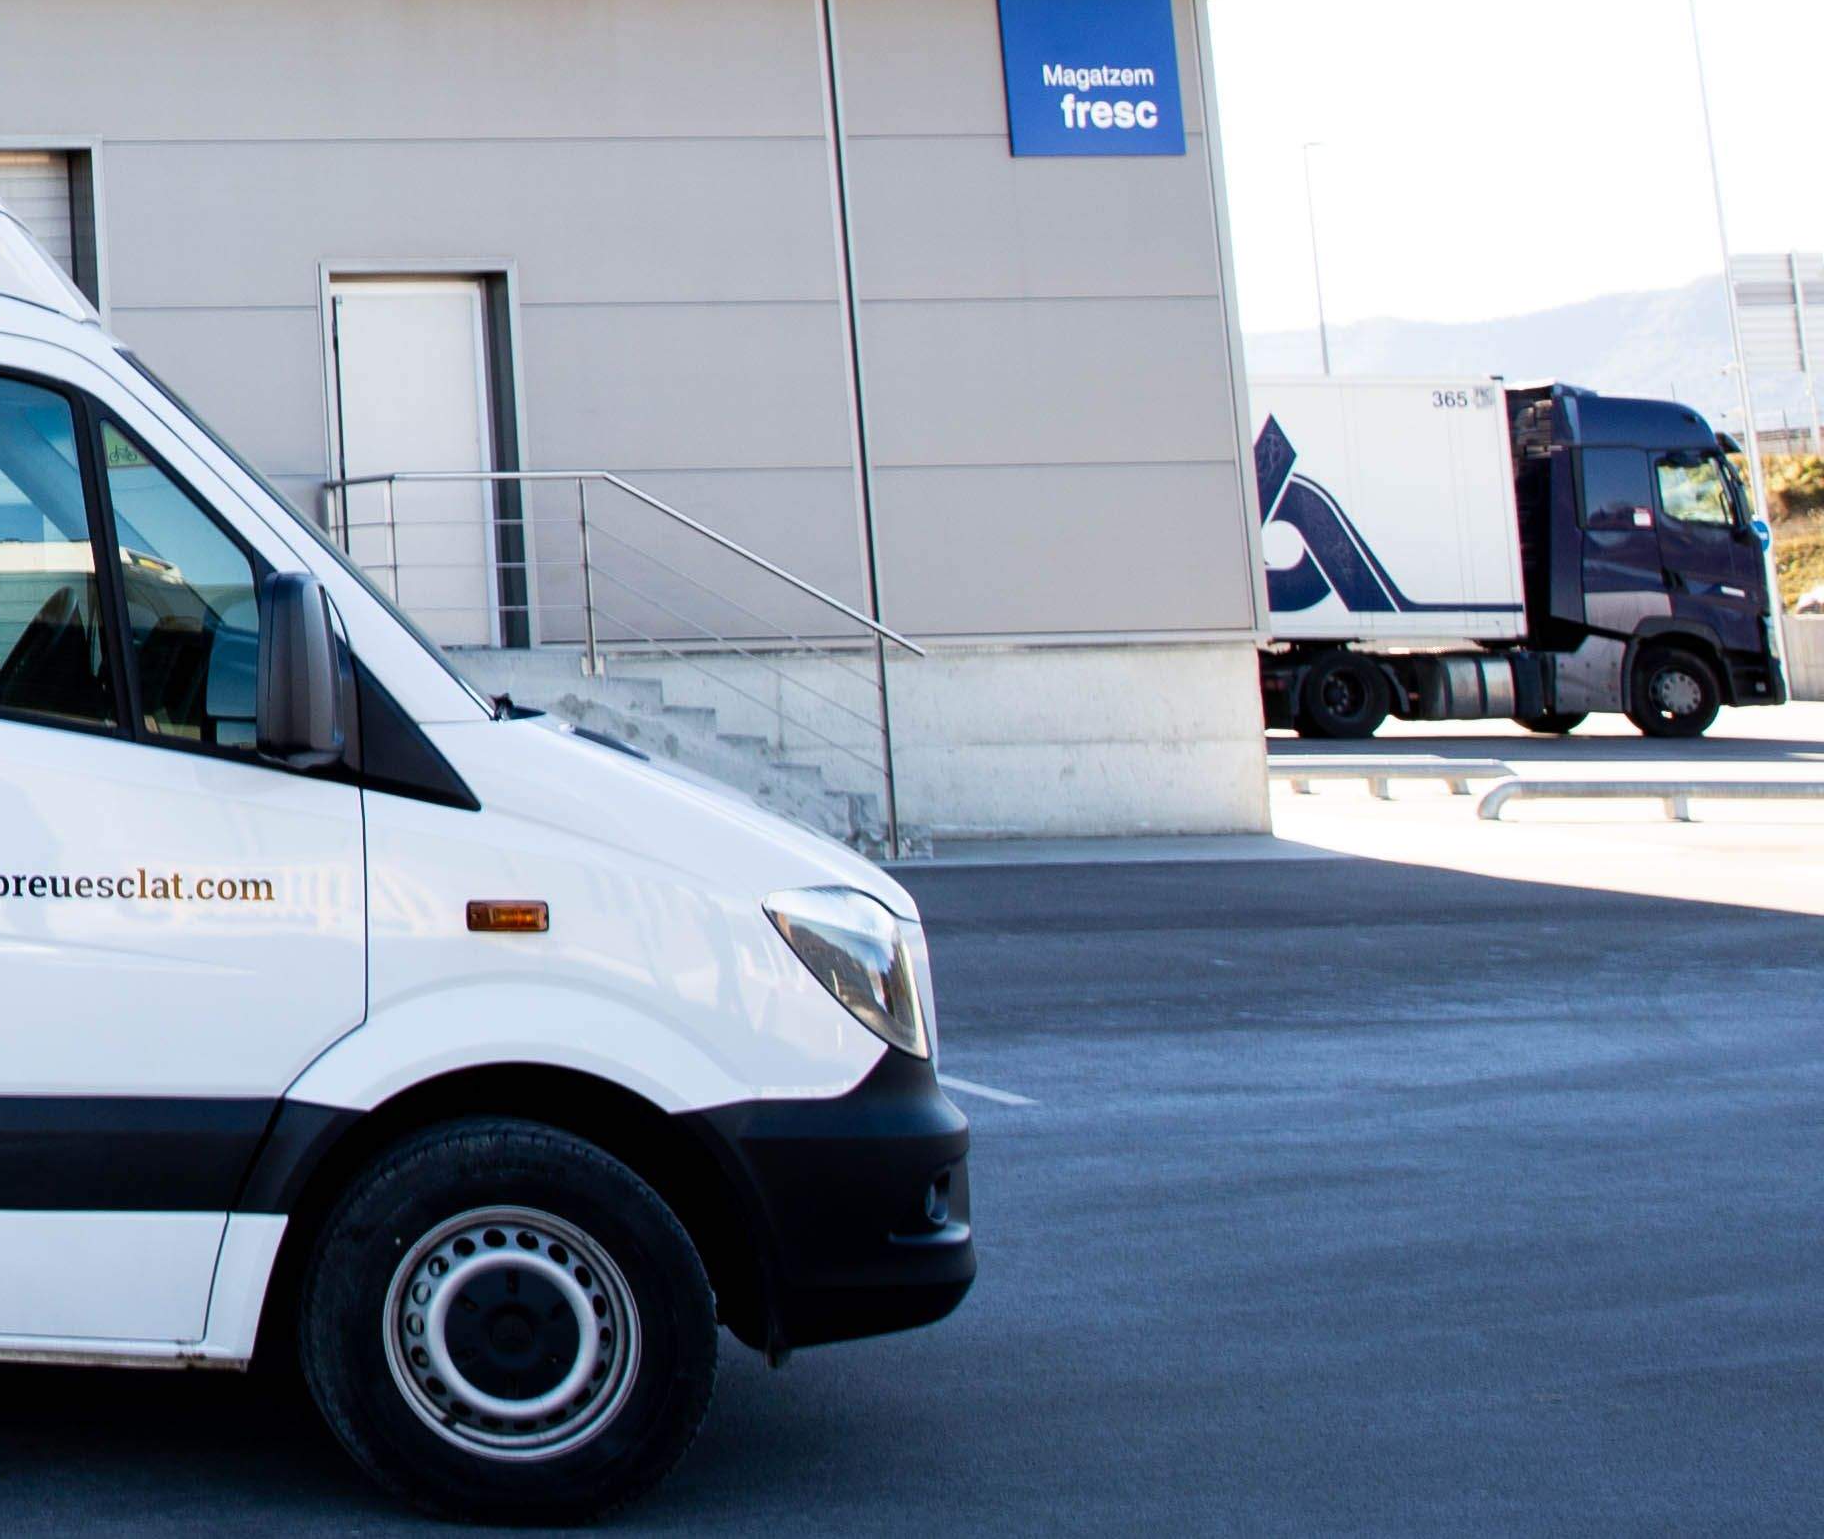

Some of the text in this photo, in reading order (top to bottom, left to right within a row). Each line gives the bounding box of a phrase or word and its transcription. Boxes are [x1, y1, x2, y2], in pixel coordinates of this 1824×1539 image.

[1042, 63, 1155, 92] Magatzem
[1060, 93, 1158, 129] fresc
[1432, 390, 1468, 407] 365
